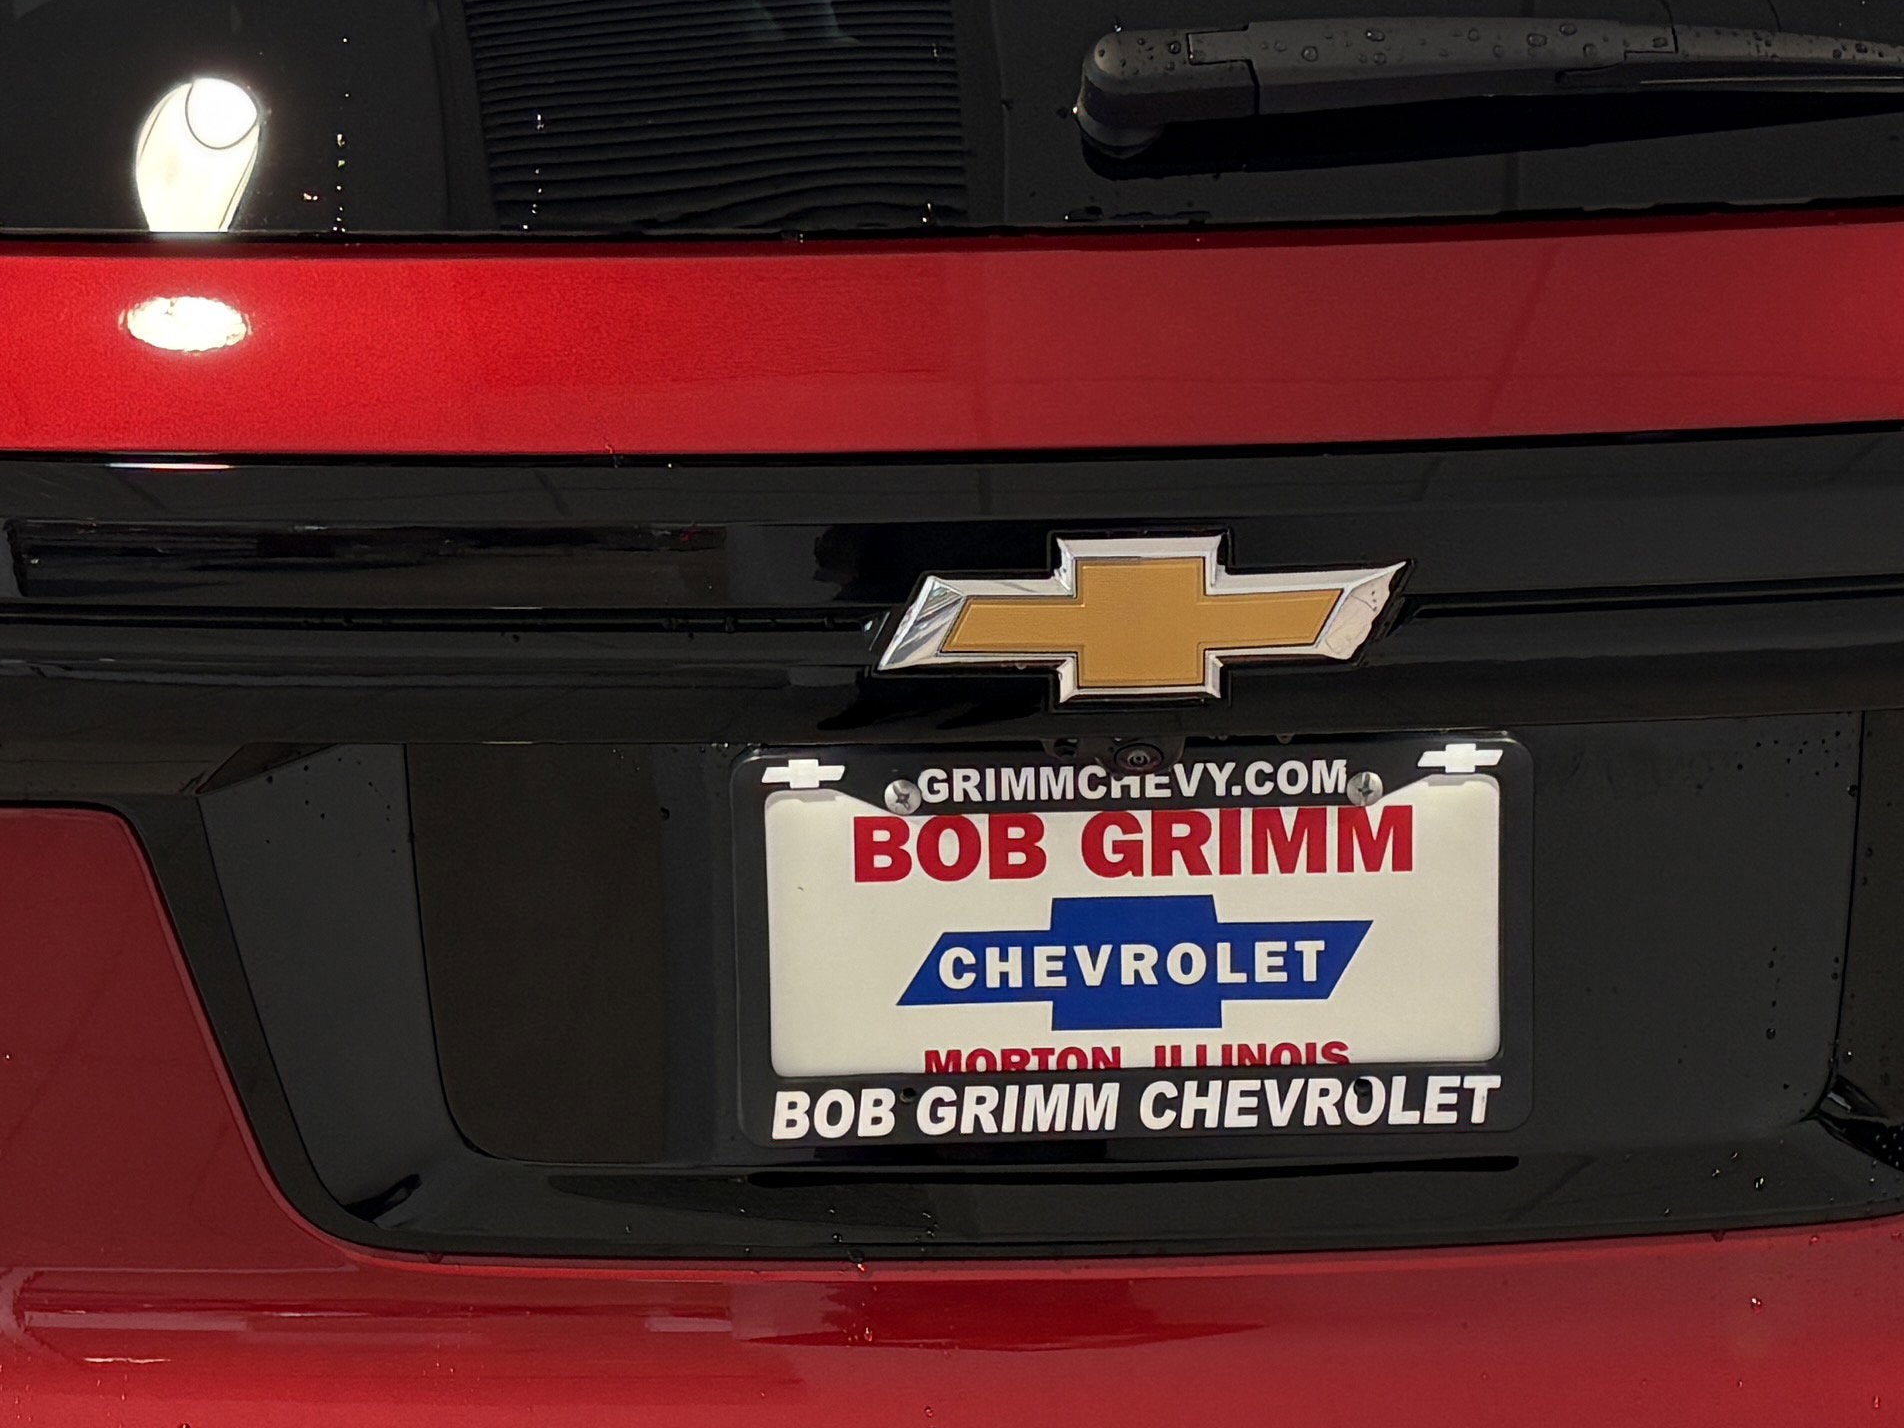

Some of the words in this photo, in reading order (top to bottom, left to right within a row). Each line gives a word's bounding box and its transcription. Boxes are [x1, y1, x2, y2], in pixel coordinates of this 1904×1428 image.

[918, 758, 1348, 805] GRIMMCHEVY.COM
[853, 812, 1047, 883] BOB
[1081, 805, 1414, 878] GRIMM
[939, 939, 1326, 989] CHEVROLET
[772, 1089, 896, 1140] BOB
[916, 1081, 1119, 1135] GRIMM
[1139, 1075, 1502, 1131] CHEVROLET
